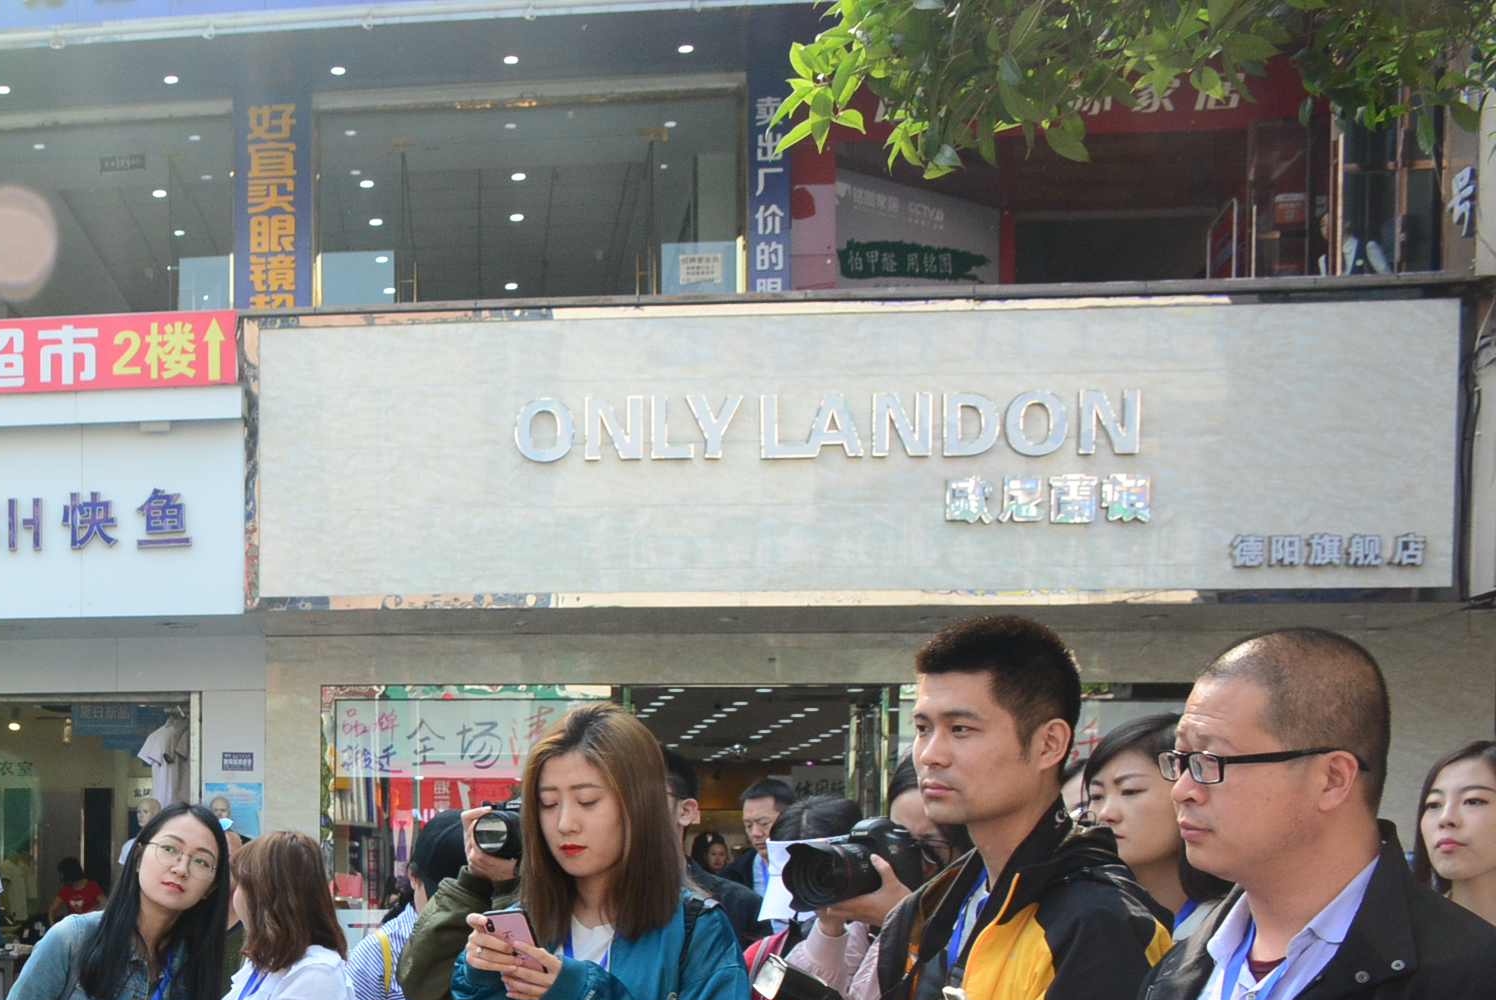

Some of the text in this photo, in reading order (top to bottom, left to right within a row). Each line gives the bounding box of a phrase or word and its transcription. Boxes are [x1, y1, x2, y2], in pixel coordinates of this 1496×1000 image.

[61, 486, 193, 552] 快鱼
[1230, 533, 1427, 569] 德阳旗舰店
